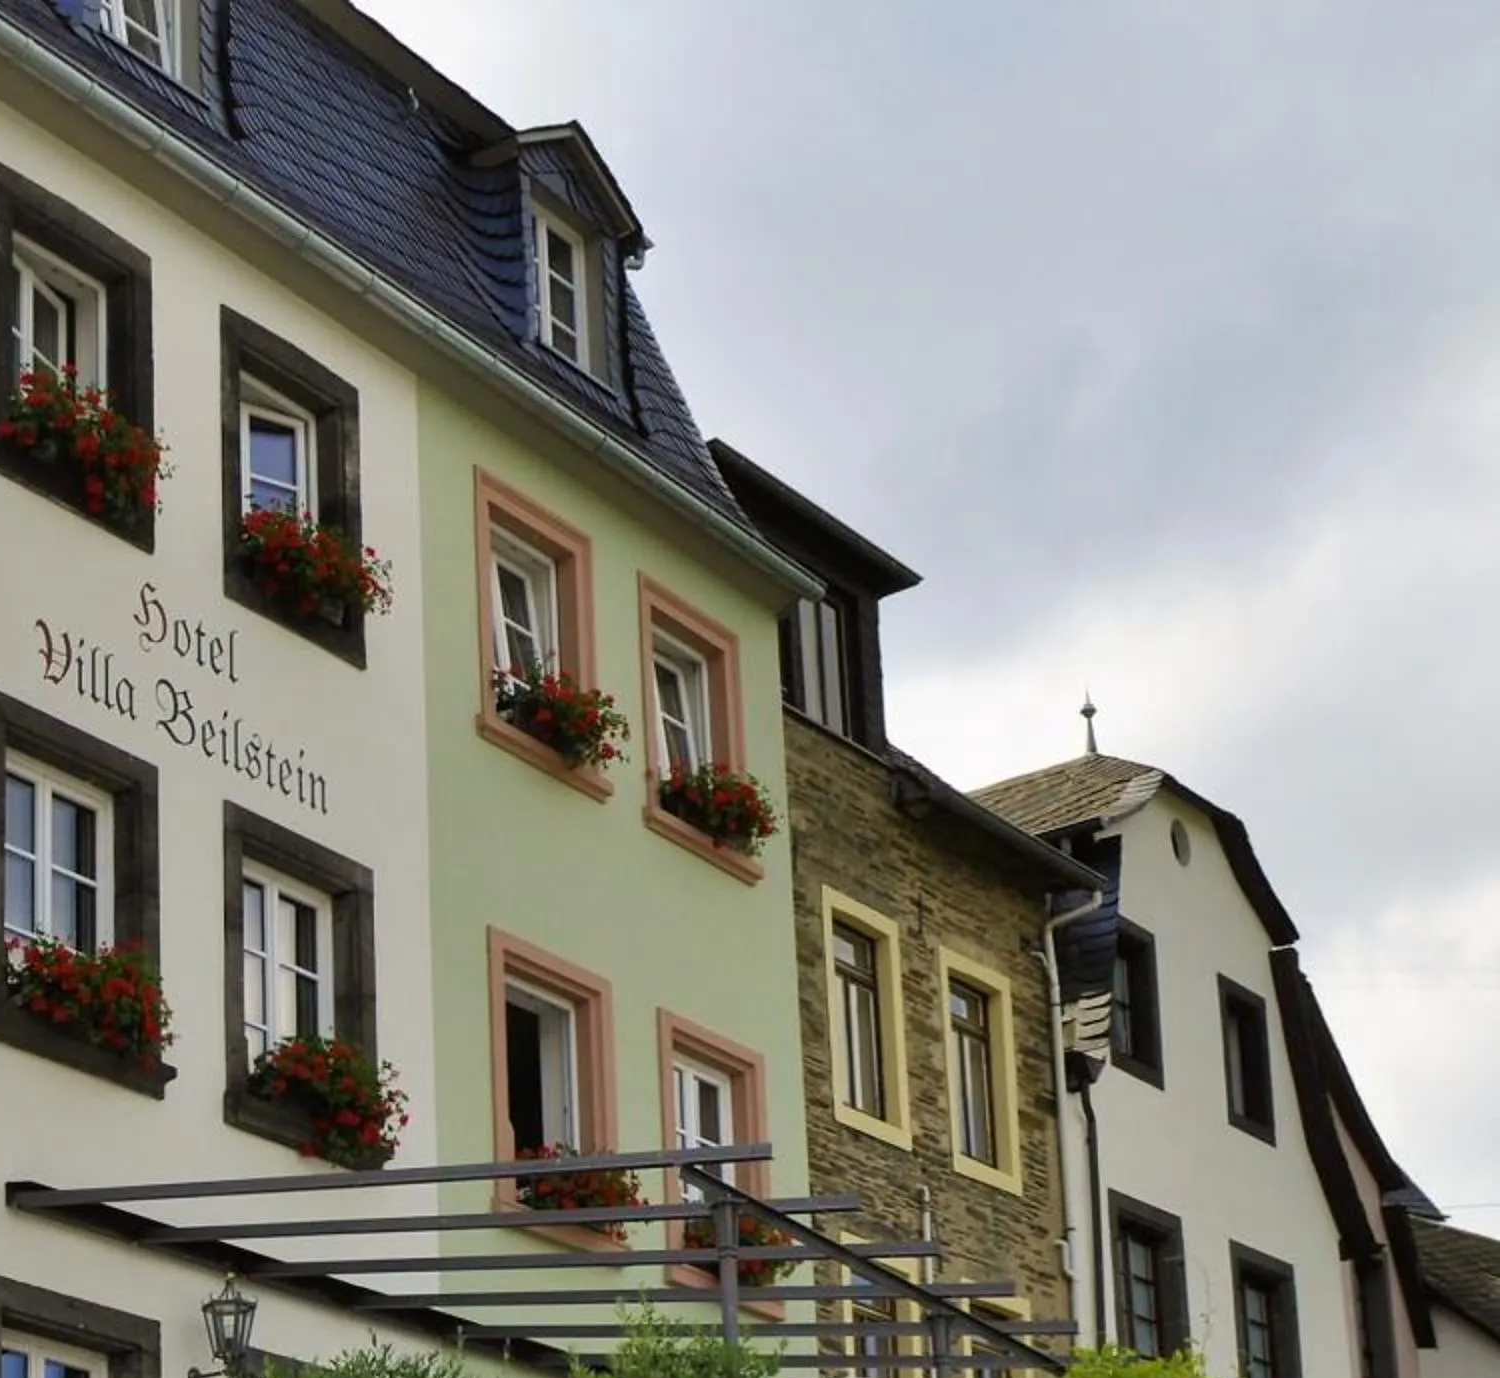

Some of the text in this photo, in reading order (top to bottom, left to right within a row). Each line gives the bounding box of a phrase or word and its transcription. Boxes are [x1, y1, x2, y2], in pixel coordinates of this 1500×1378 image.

[133, 582, 238, 683] Hotel
[35, 619, 328, 815] Villa Beilstein
